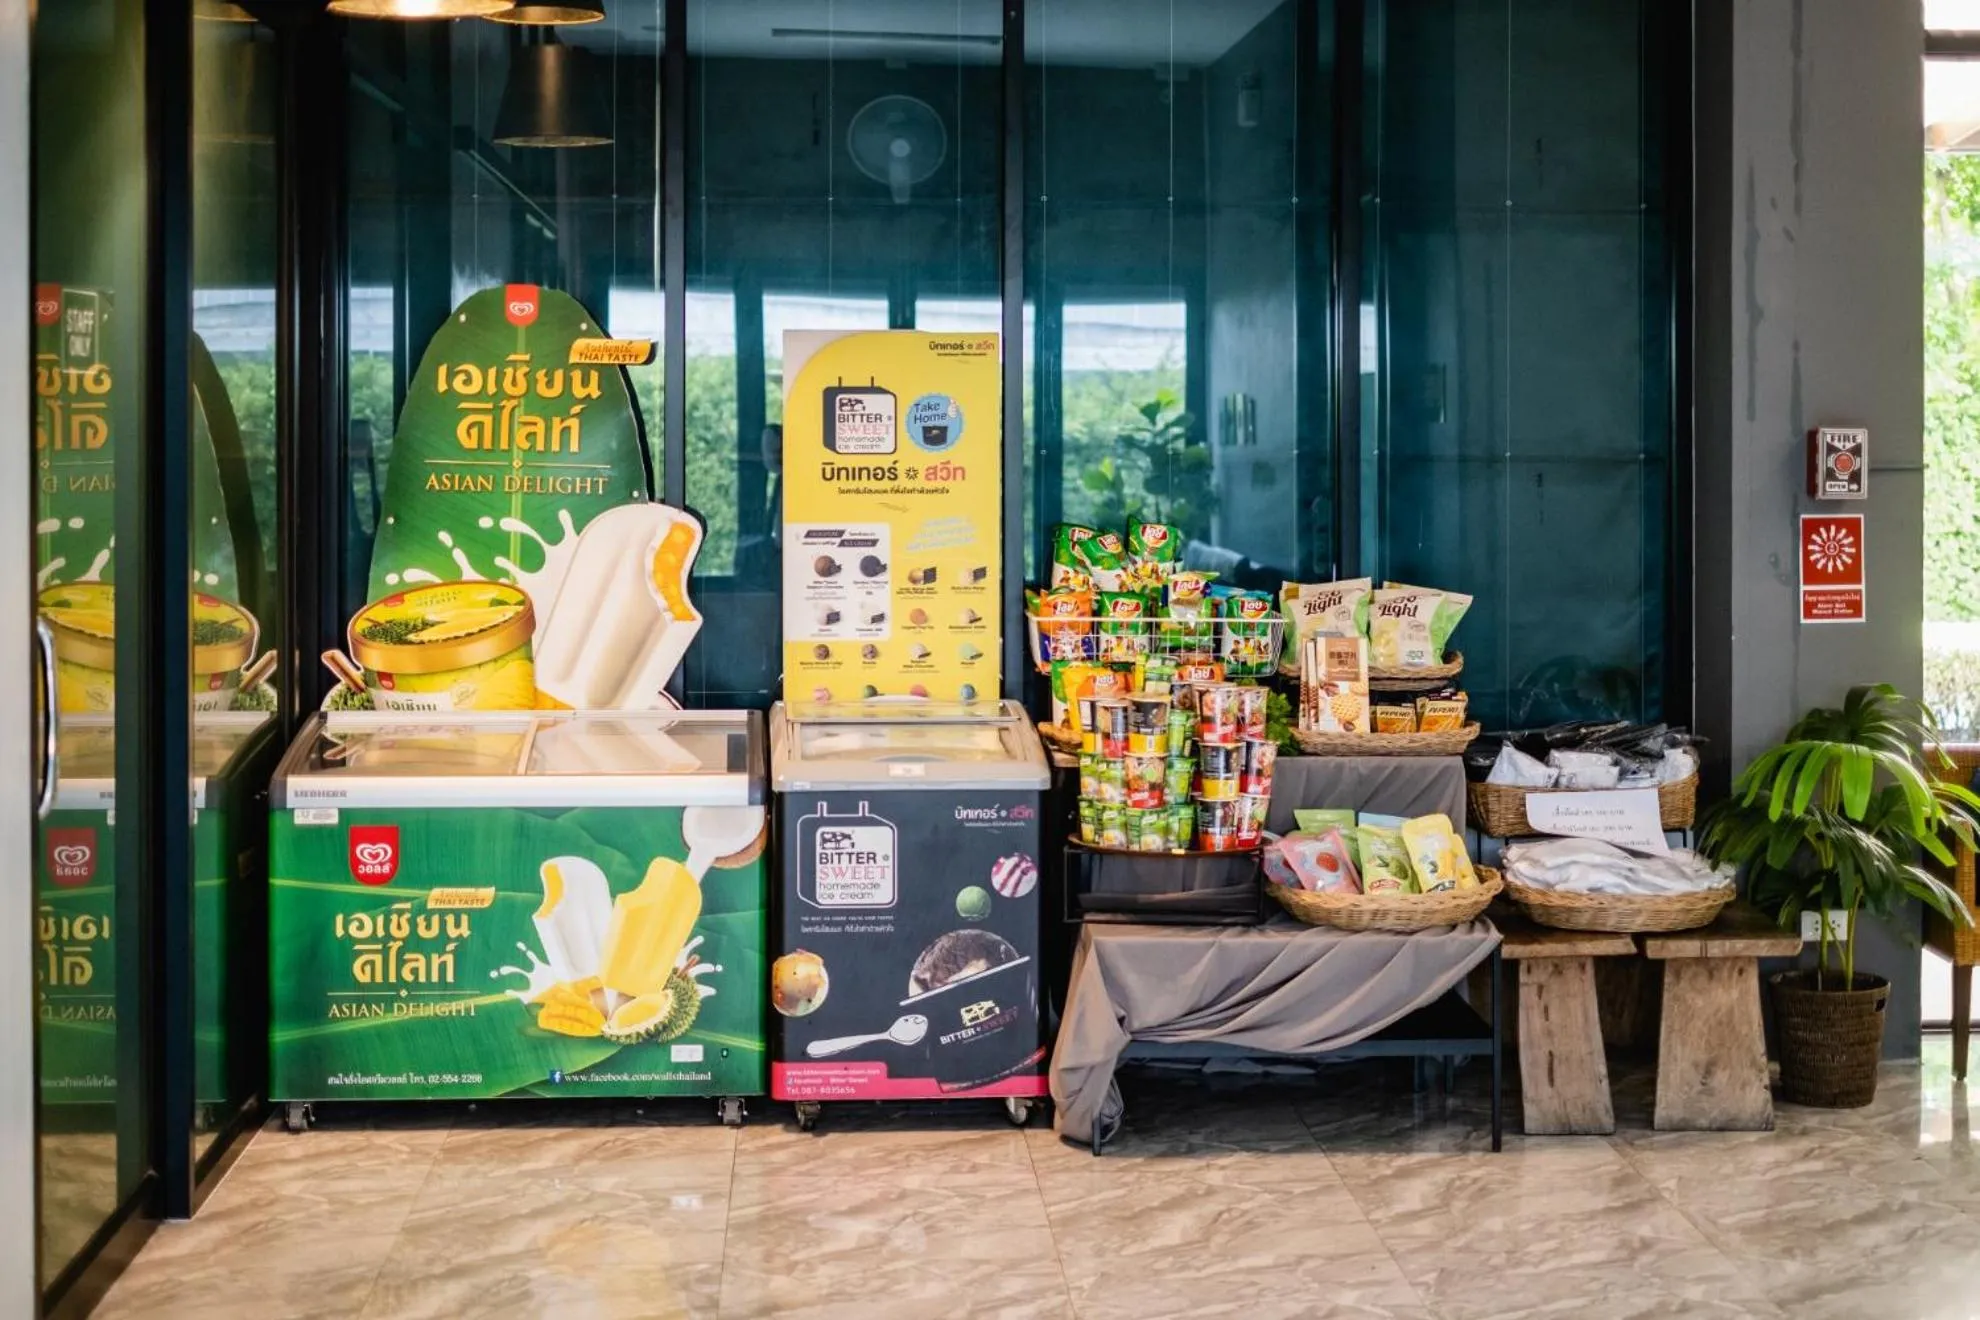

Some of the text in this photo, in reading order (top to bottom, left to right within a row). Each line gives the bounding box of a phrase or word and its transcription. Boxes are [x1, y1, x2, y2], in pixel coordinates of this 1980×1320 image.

[66, 308, 95, 334] STAFF
[578, 352, 640, 362] THAI TASTE
[436, 353, 602, 400] เอเชียน
[914, 401, 940, 413] Take
[456, 399, 585, 453] ดิไลท์
[837, 412, 883, 424] BITTER
[914, 412, 947, 425] Home
[838, 424, 890, 436] SWEET
[1831, 434, 1858, 443] FIRE
[821, 459, 966, 482] บิทเทอร์ สวีท
[425, 473, 610, 496] ASIAN DELIGHT
[1304, 595, 1344, 616] Light
[1378, 602, 1419, 618] Light
[819, 851, 878, 865] BITTER
[358, 862, 393, 875] วอลล์
[819, 865, 890, 881] SWEET
[819, 881, 881, 890] homemade
[459, 898, 486, 906] TASTE
[819, 891, 874, 900] ice cream
[334, 902, 471, 939] เอเชียน
[352, 940, 459, 984] ดิไลท์
[327, 1001, 477, 1018] ASIAN DELIGHT
[939, 1028, 976, 1045] BITTER
